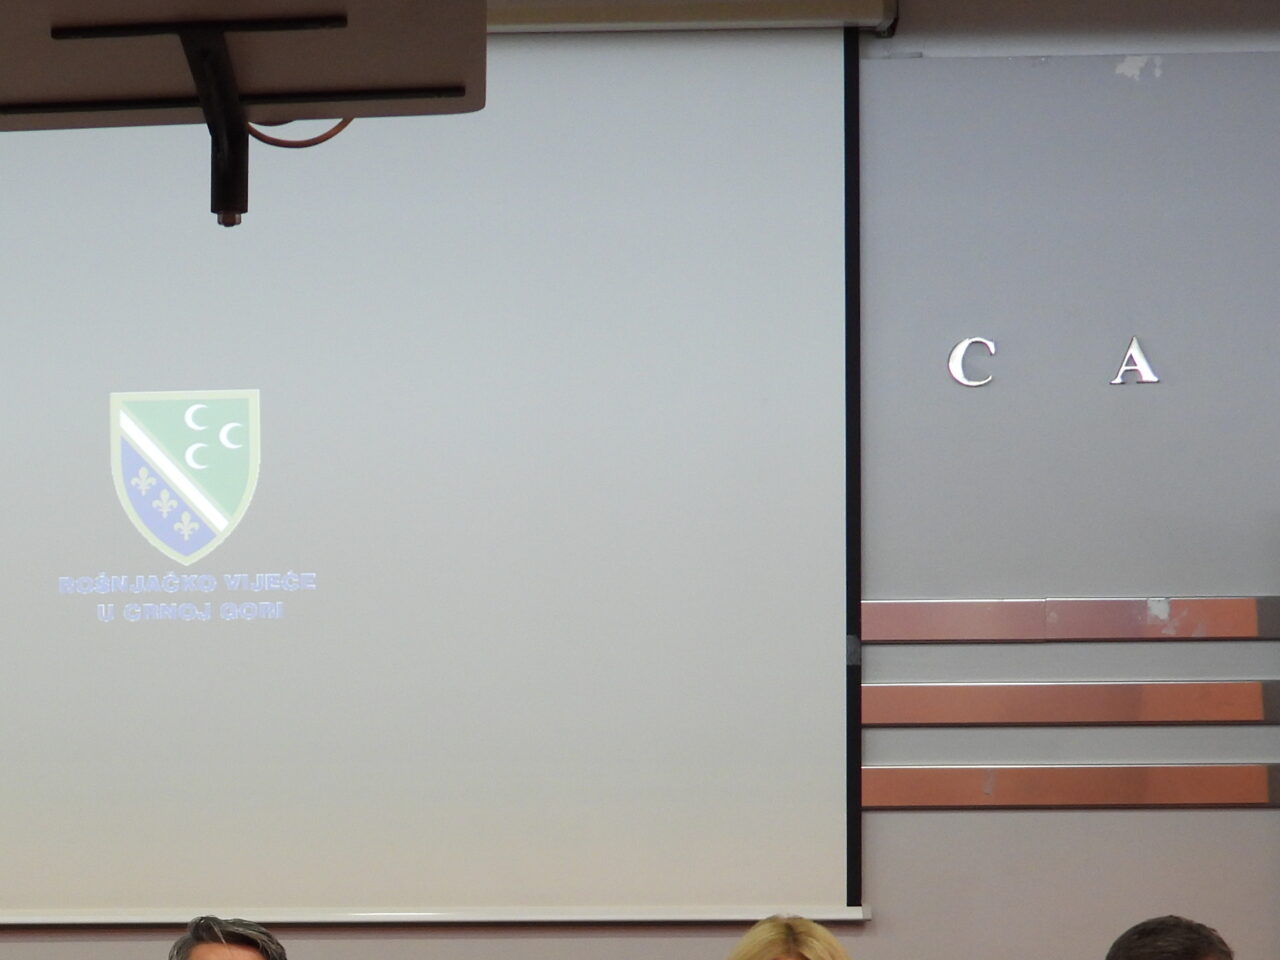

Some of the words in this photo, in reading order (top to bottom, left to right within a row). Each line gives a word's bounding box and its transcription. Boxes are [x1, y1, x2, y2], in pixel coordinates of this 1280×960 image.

[58, 570, 217, 594] BOŠNJAČKO
[96, 602, 115, 622] U
[123, 601, 212, 622] CRNOJ
[220, 600, 285, 620] GORI
